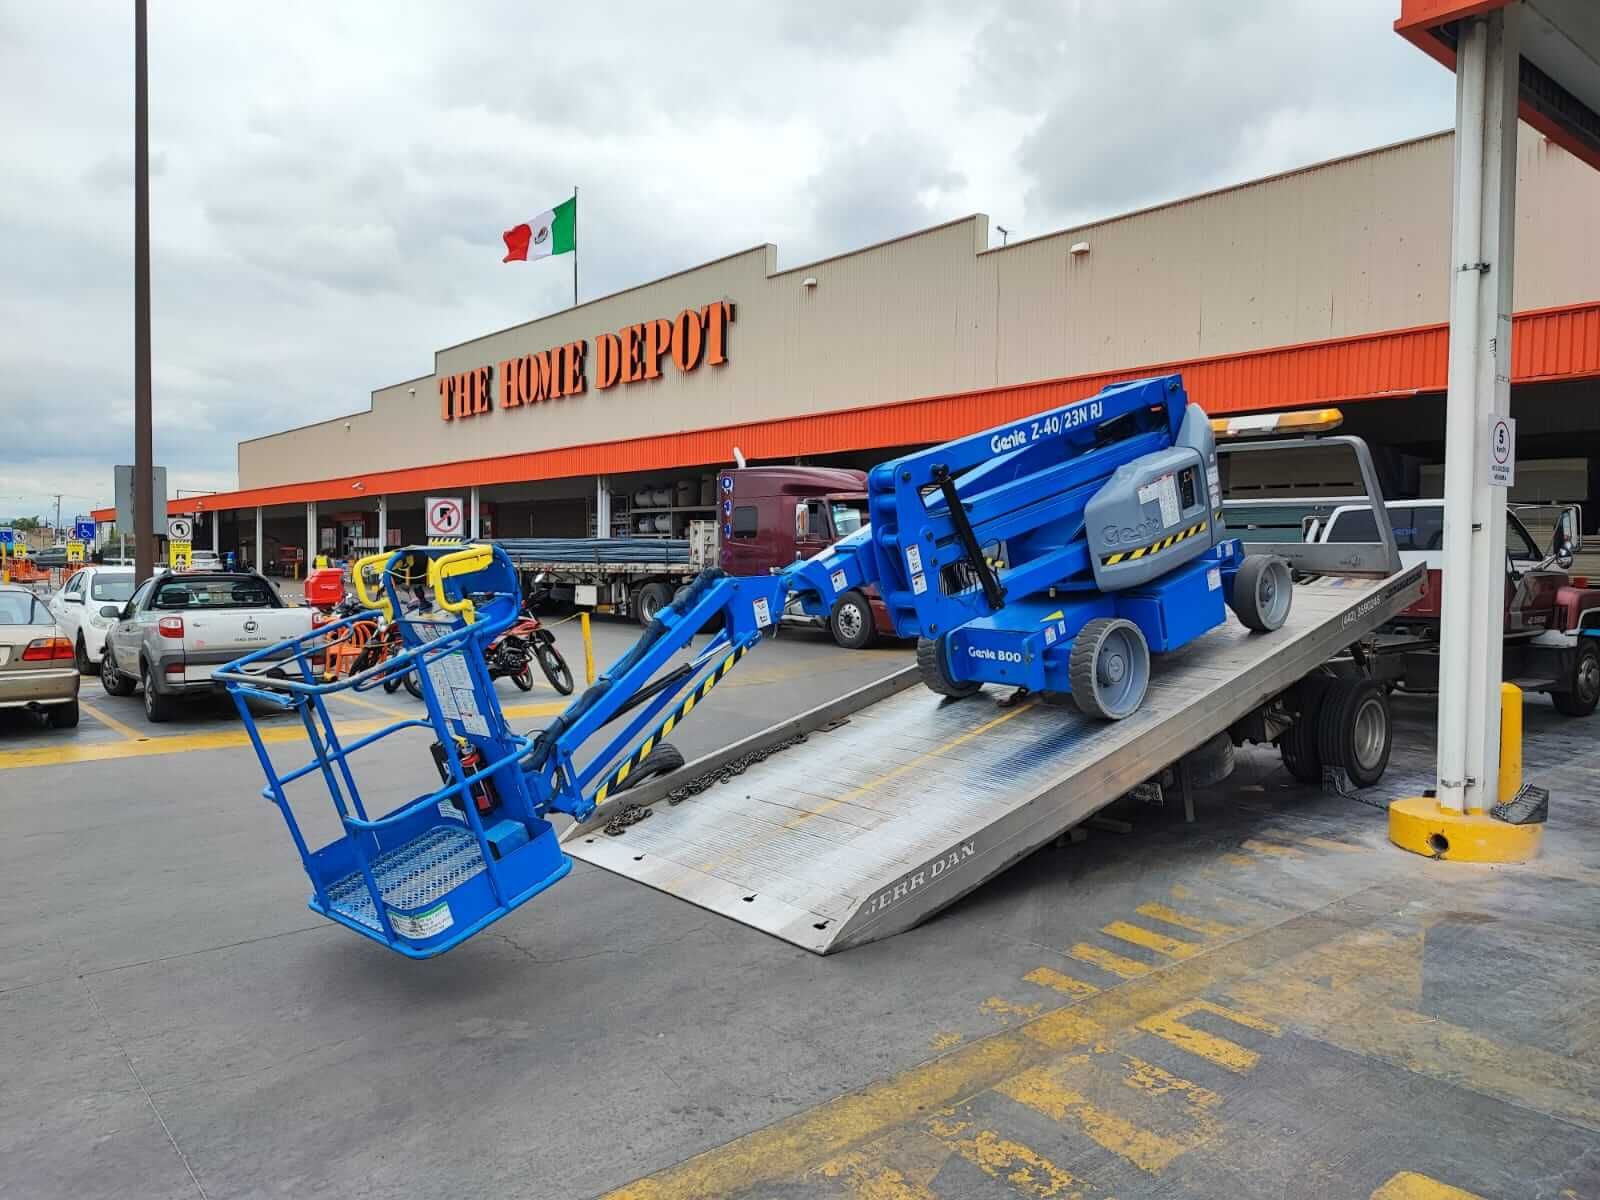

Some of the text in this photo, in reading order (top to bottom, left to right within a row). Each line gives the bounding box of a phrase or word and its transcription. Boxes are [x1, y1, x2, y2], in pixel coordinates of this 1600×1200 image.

[438, 301, 735, 421] THE HOME DEPOT
[990, 401, 1103, 453] Genie Z-40/23N RJ
[1498, 429, 1504, 444] 5
[968, 646, 1022, 663] Genie 800
[931, 840, 976, 878] DAN
